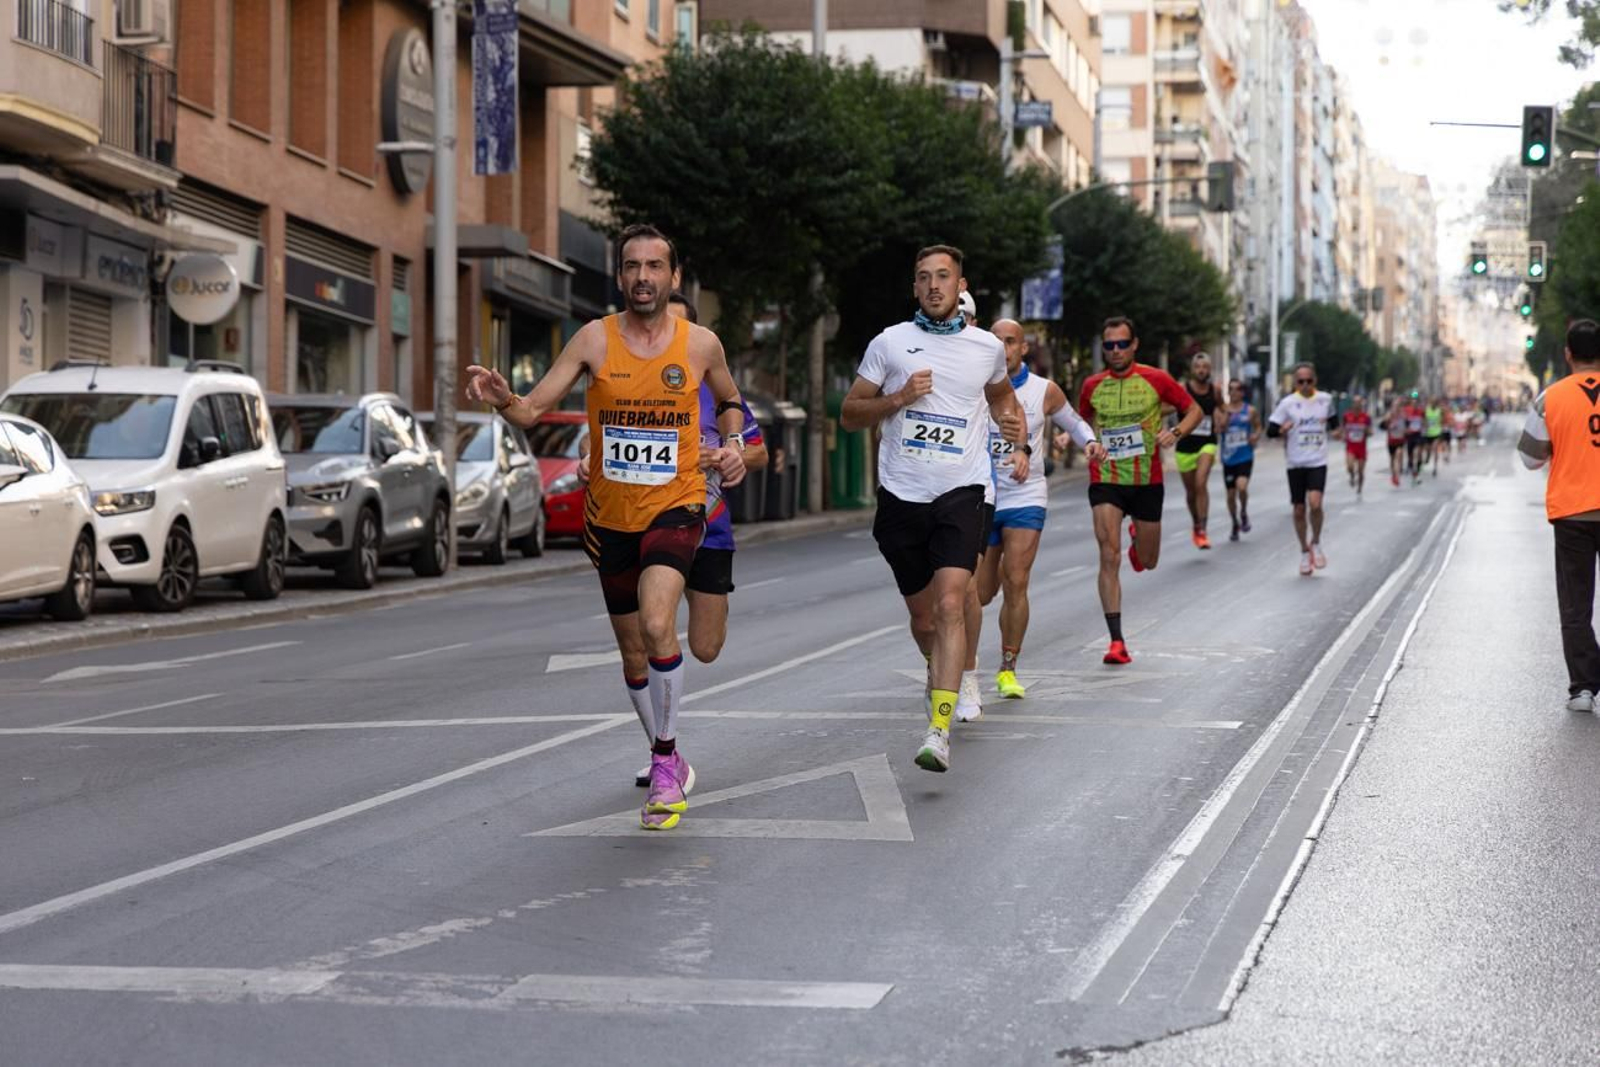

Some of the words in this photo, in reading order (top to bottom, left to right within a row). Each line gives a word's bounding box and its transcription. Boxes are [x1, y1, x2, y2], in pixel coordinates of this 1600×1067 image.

[913, 424, 955, 446] 242
[1109, 434, 1134, 448] 521
[610, 442, 672, 464] 1014
[992, 441, 1014, 454] 22
